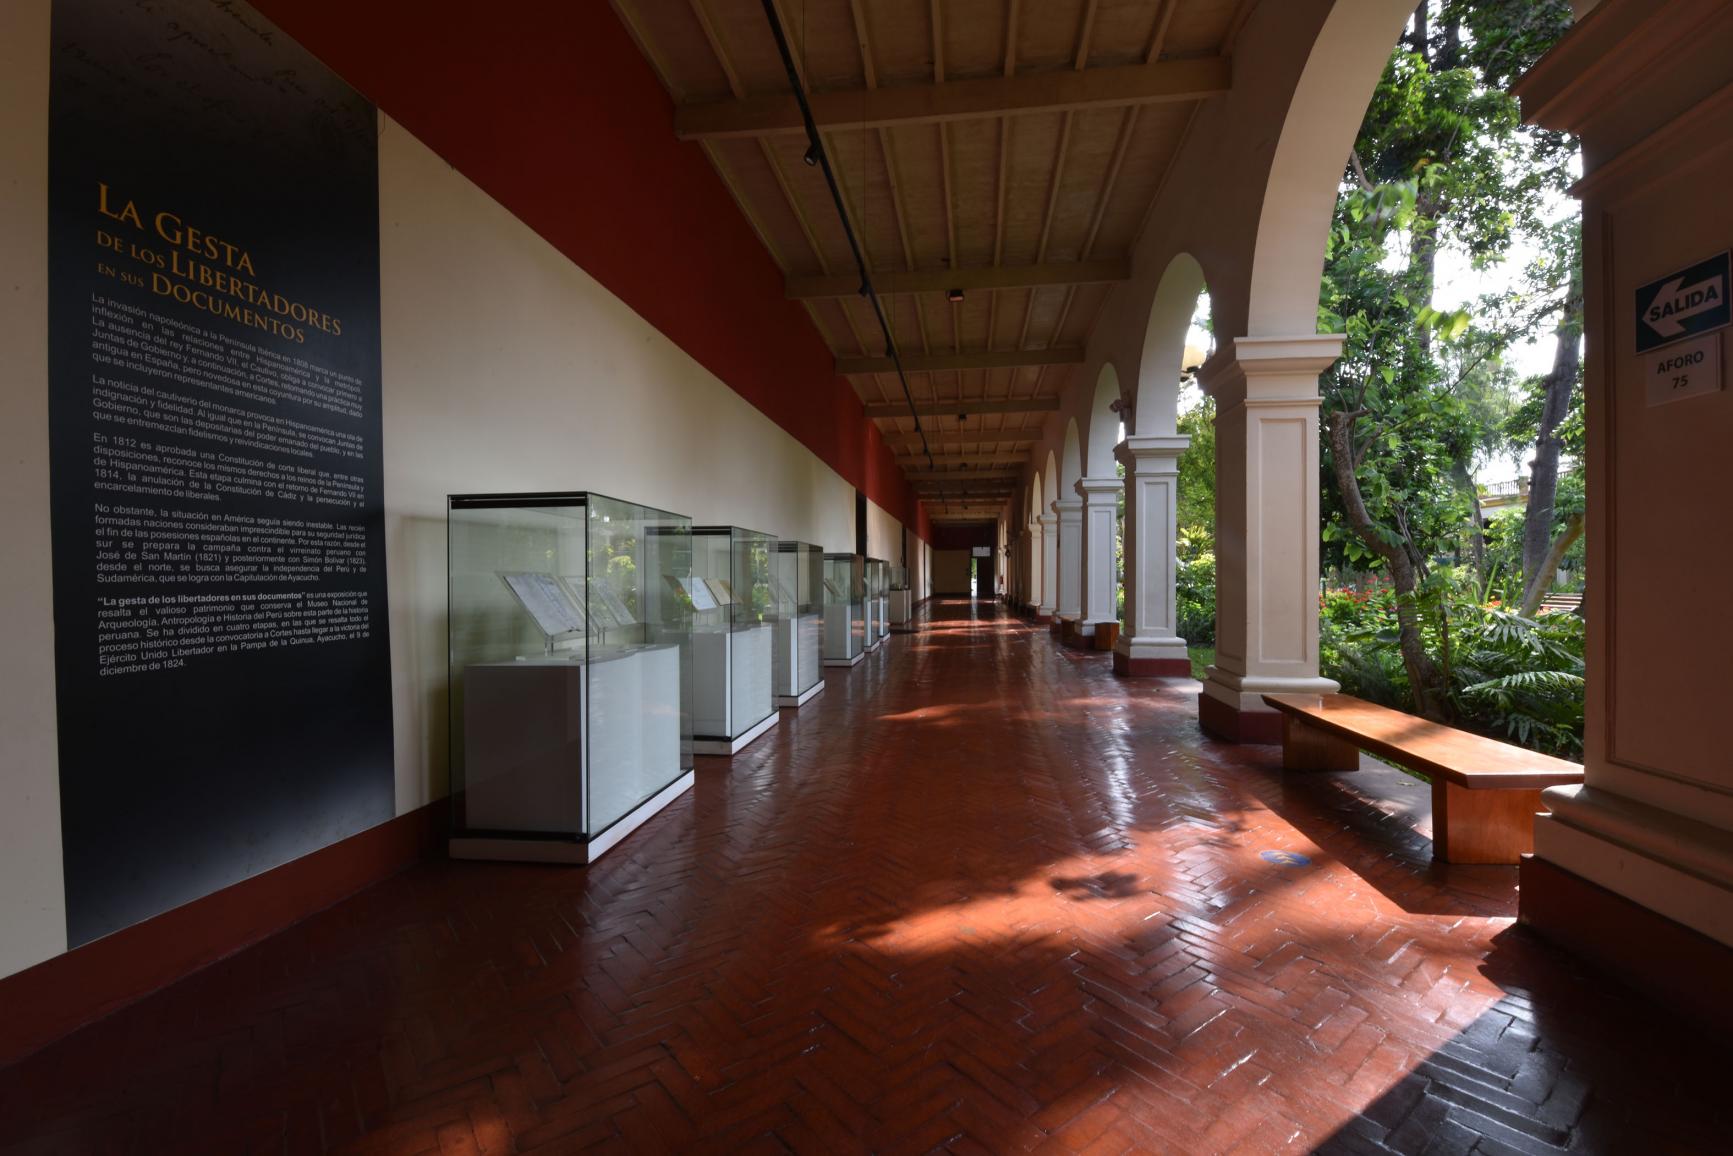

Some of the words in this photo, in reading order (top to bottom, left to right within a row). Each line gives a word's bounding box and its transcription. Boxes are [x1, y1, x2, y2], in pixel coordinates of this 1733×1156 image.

[96, 181, 145, 230] LA
[155, 212, 256, 277] GESTA
[97, 231, 123, 254] DE
[131, 244, 165, 269] LOS
[170, 250, 341, 336] LIBERTADORES
[98, 263, 116, 278] EN
[120, 271, 144, 288] SUS
[151, 272, 305, 344] DOCUMENTOS
[1649, 285, 1719, 322] SALIDA
[1657, 350, 1704, 375] AFORO
[1672, 375, 1688, 389] 75
[93, 386, 148, 407] indignación
[108, 378, 139, 392] noticia
[141, 386, 154, 396] del
[156, 389, 197, 405] cautiverio
[199, 399, 210, 408] del
[92, 411, 112, 423] que
[127, 416, 187, 434] entremezclan
[189, 428, 228, 442] fidelismos
[144, 410, 161, 421] que
[163, 414, 178, 423] son
[181, 416, 193, 426] las
[195, 419, 242, 437] depositarias
[113, 437, 137, 448] 1812
[155, 444, 196, 459] aprobada
[163, 457, 202, 468] reconoce
[204, 462, 215, 470] los
[142, 474, 184, 486] anulación
[189, 470, 207, 479] Esta
[94, 480, 172, 496] encarcelamiento
[172, 510, 208, 520] situación
[95, 516, 141, 526] formadas
[144, 519, 183, 529] naciones
[185, 522, 238, 532] consideraban
[107, 528, 118, 536] fin
[135, 530, 148, 538] las
[151, 531, 199, 542] posesiones
[201, 533, 240, 544] españolas
[143, 543, 180, 552] prepara
[203, 544, 241, 553] campaña
[96, 551, 120, 559] José
[195, 553, 221, 562] (1821)
[96, 562, 127, 570] desde
[188, 574, 208, 583] logra
[119, 597, 146, 607] gesta
[178, 594, 229, 603] libertadores
[98, 608, 131, 618] resalta
[156, 606, 186, 615] valioso
[193, 604, 234, 614] patrimonio
[161, 615, 214, 627] Antropología
[178, 626, 210, 635] dividido
[99, 643, 139, 654] proceso
[140, 638, 178, 648] histórico
[180, 636, 205, 645] desde
[100, 652, 137, 666] Ejército
[141, 650, 168, 660] Unido
[172, 646, 214, 656] Libertador
[99, 663, 147, 676] diciembre
